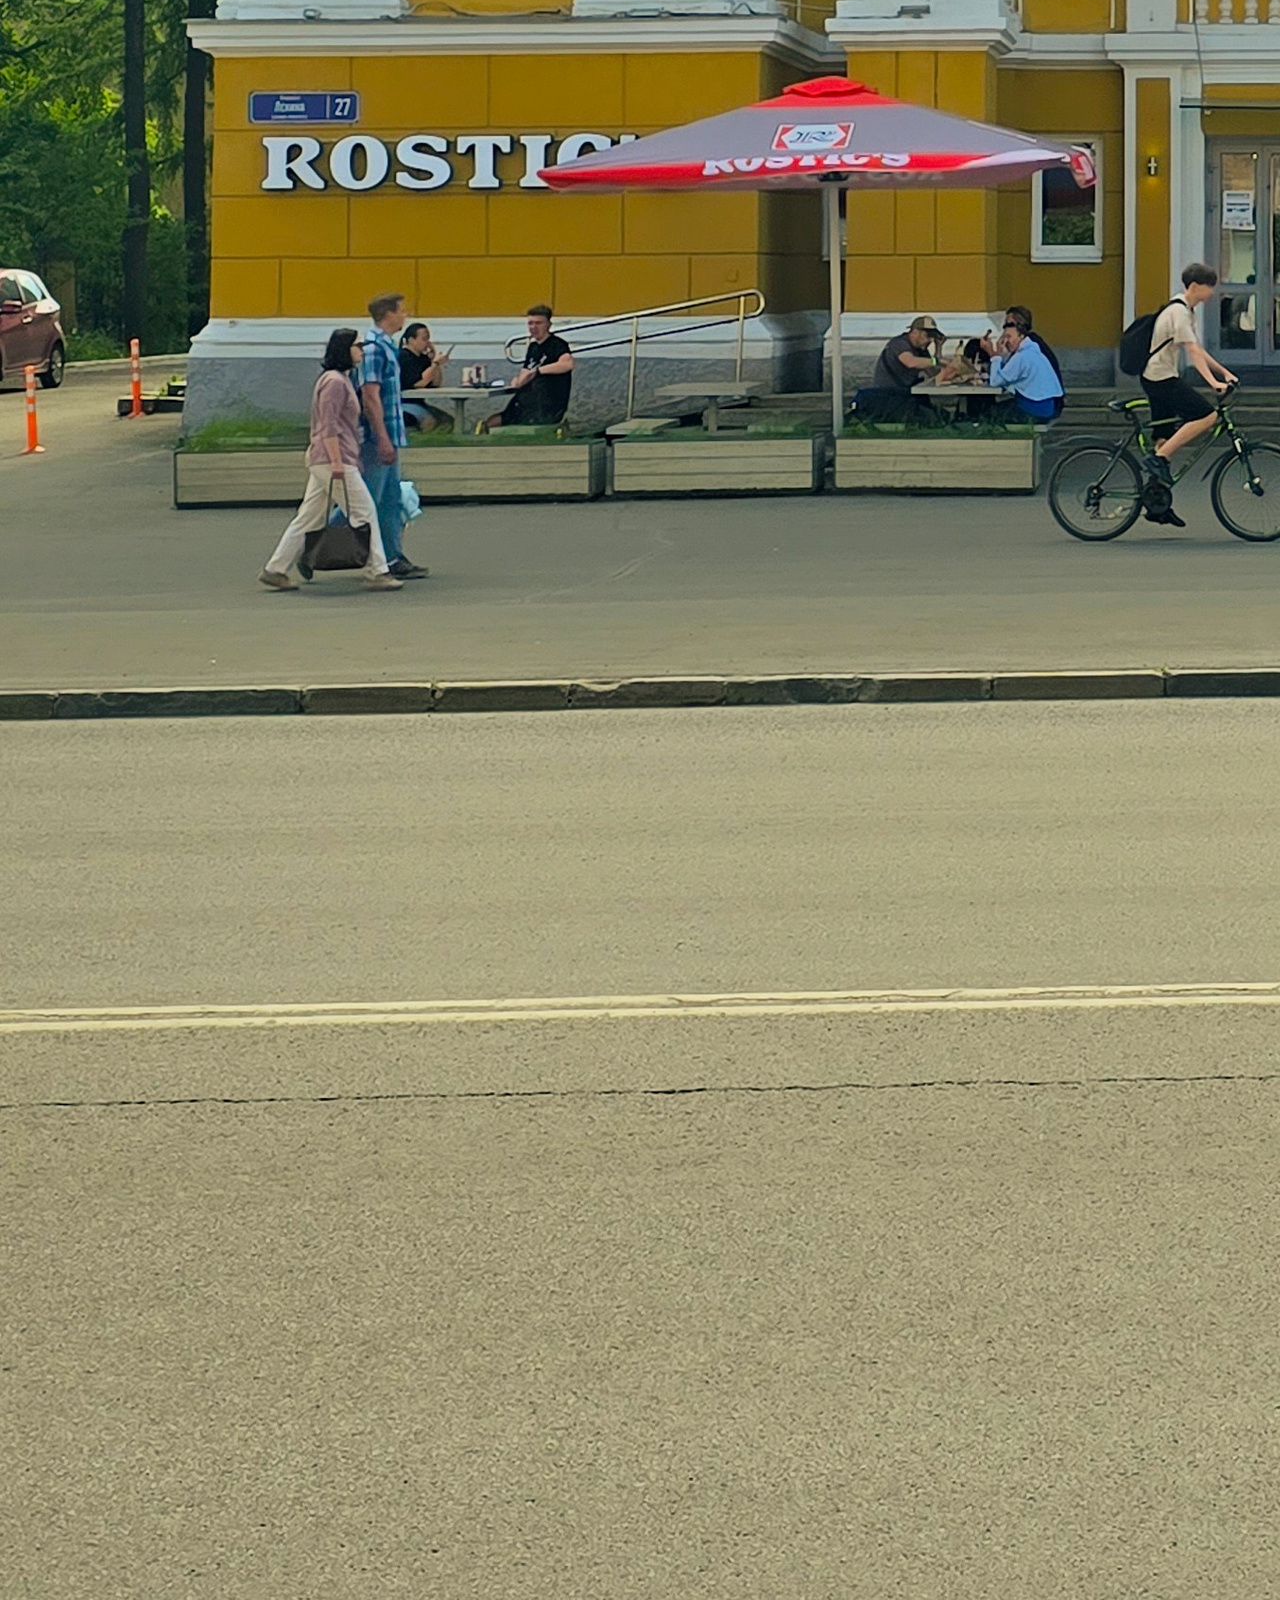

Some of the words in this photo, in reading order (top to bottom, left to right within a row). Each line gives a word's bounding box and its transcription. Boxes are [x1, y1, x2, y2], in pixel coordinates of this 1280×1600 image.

[334, 98, 351, 116] 27
[262, 134, 638, 190] ROSTI
[701, 152, 911, 176] ROSTICS
